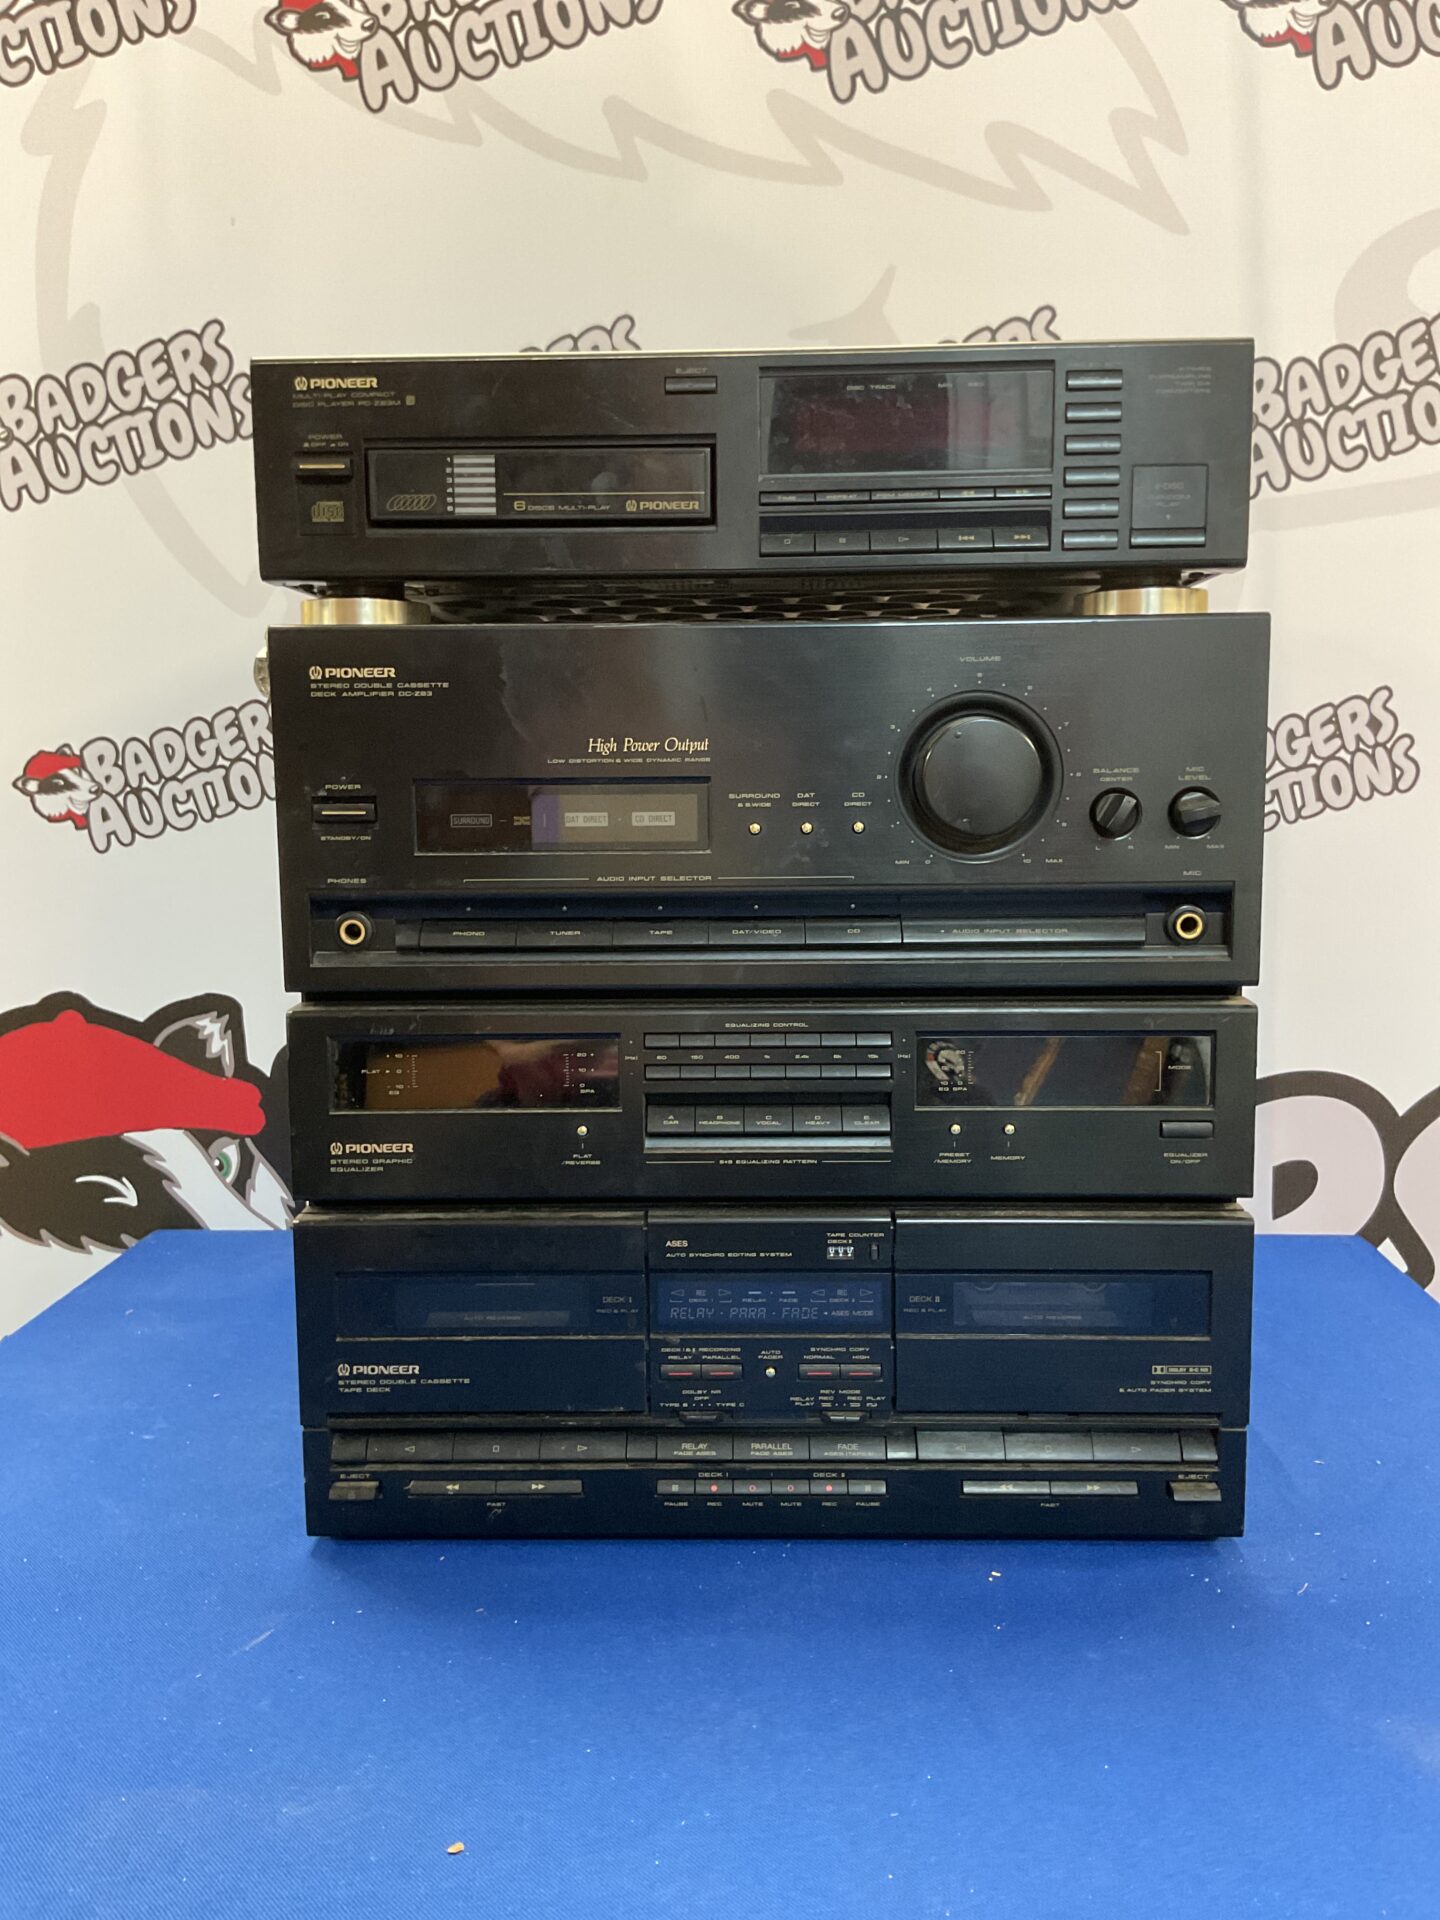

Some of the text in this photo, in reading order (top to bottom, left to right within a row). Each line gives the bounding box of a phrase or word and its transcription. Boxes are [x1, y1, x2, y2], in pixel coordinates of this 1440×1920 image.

[826, 0, 1138, 104] AUCTIO
[1252, 312, 1440, 432] BADGE
[0, 319, 233, 446] BADGERS
[309, 377, 378, 389] PIONEER
[1249, 380, 1440, 500] AUCTIO
[514, 501, 526, 511] 6
[640, 501, 699, 511] PIONEER
[325, 667, 396, 679] PIONEER
[1266, 685, 1398, 773] GERS
[80, 699, 273, 796] BADGER
[588, 737, 709, 755] High Power Output
[1264, 733, 1421, 832] TIONS
[87, 750, 276, 854] AUCTIO
[345, 1143, 414, 1154] PIONEER
[665, 1240, 688, 1248] ASES
[602, 1296, 625, 1304] DECK
[909, 1295, 932, 1303] DECK
[670, 1307, 715, 1319] RELAY
[729, 1307, 767, 1319] PARA
[782, 1307, 819, 1319] FADE
[353, 1365, 420, 1375] PIONEER
